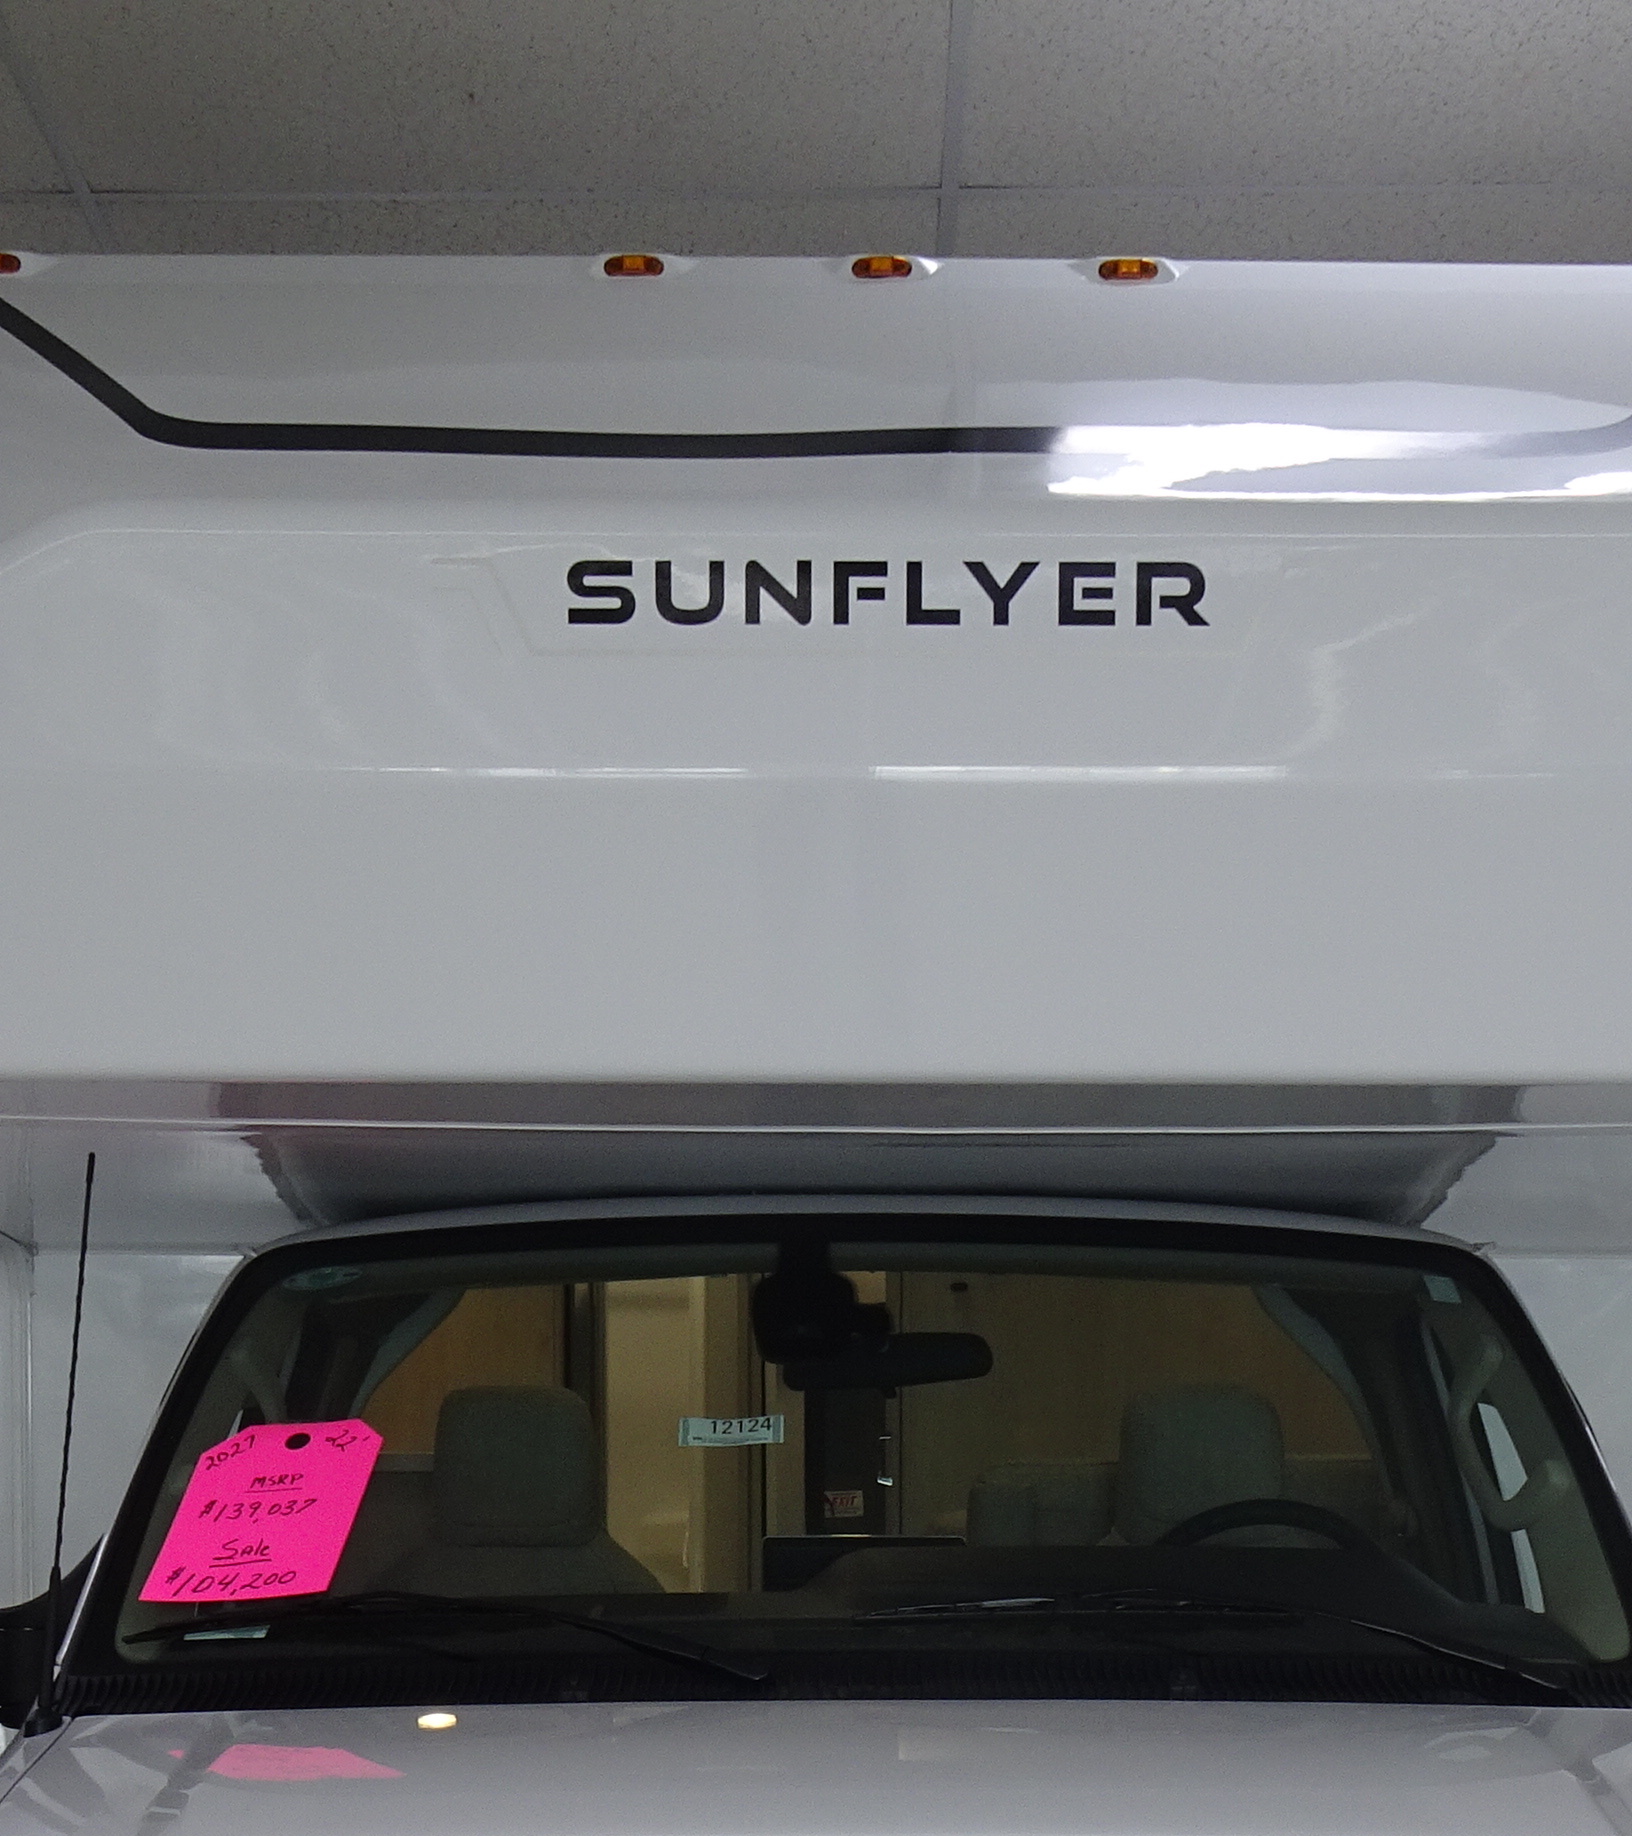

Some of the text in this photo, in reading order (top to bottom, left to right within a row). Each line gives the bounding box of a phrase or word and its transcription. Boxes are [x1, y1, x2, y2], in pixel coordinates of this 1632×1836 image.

[566, 559, 1210, 627] SUNFLYER
[711, 1417, 771, 1435] 12124
[249, 1473, 304, 1489] MSRP
[198, 1498, 318, 1524] $139,037
[165, 1565, 297, 1596] $104,200
